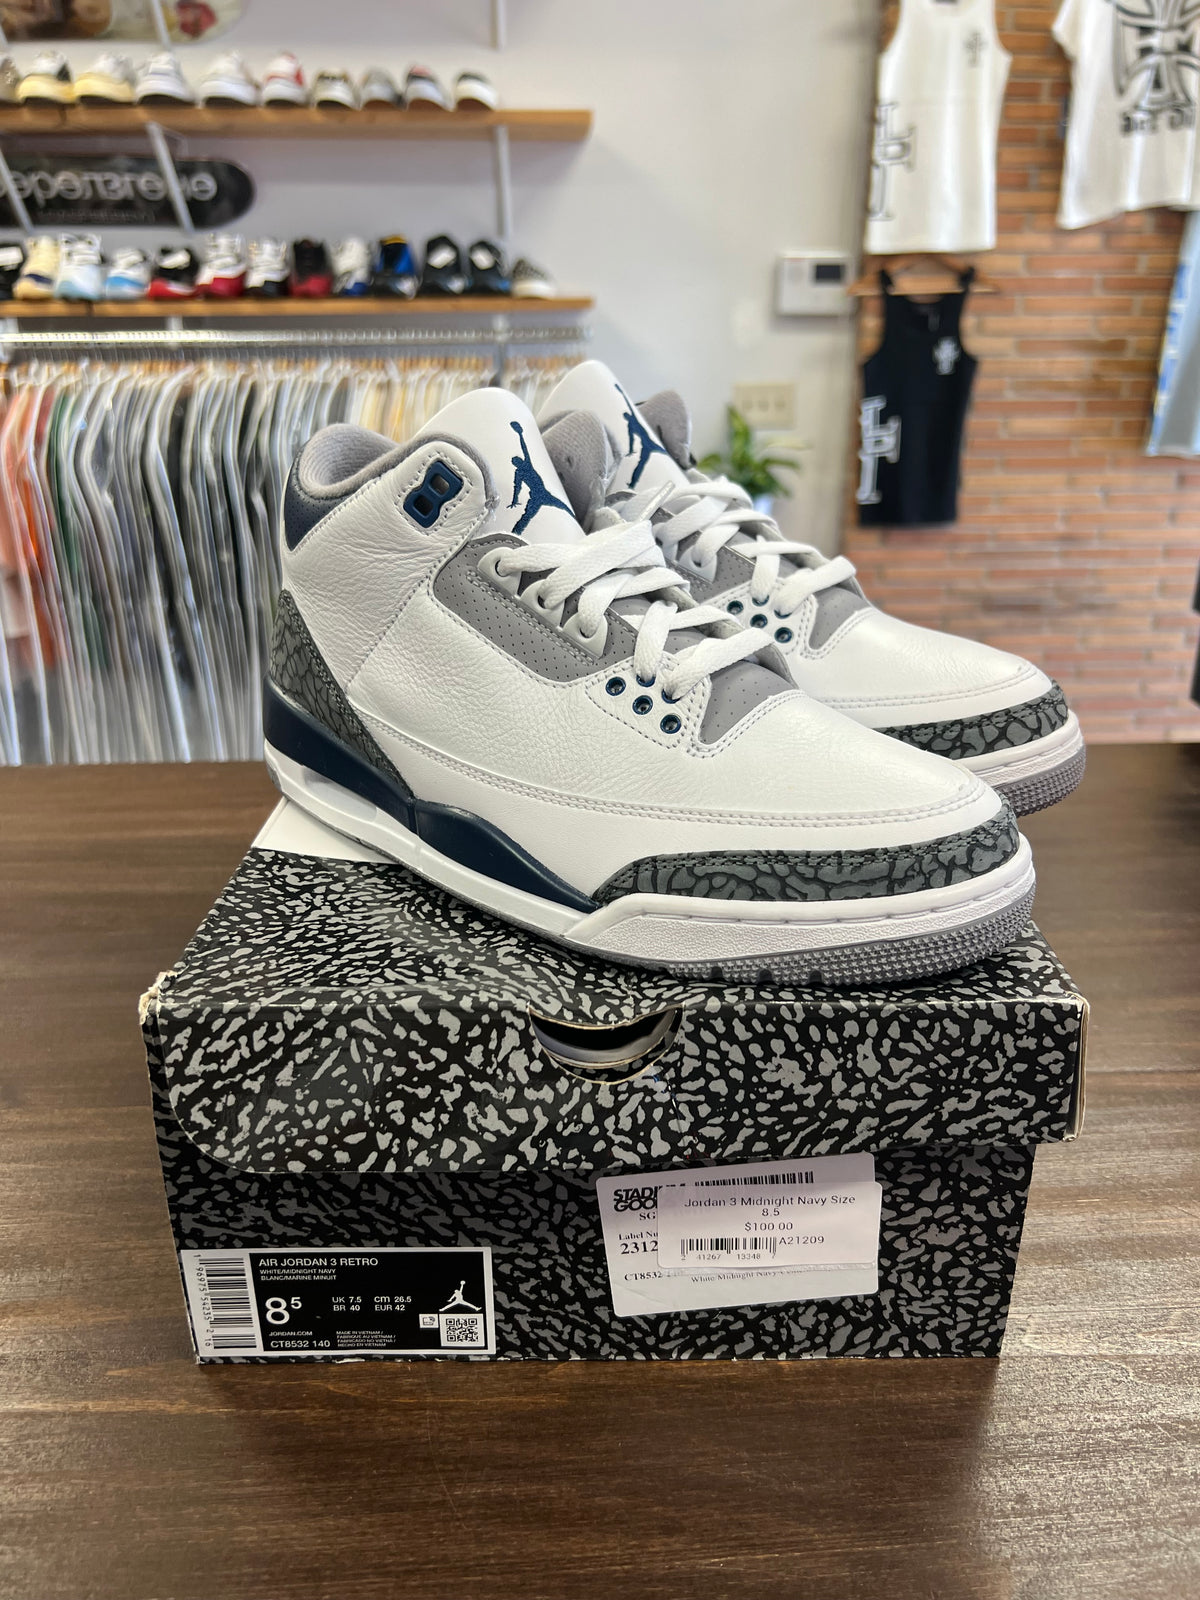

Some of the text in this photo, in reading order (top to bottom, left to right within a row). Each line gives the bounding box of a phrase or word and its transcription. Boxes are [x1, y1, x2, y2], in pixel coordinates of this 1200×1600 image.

[613, 1184, 675, 1202] STADI
[614, 1198, 658, 1212] GOO
[684, 1195, 856, 1207] Jordan 3 Midnight Navy Size
[761, 1208, 780, 1217] 8.5
[744, 1221, 793, 1232] $100.00
[619, 1231, 643, 1240] Label
[779, 1236, 825, 1245] A21209
[259, 1257, 379, 1267] AIR JORDAN 3 RETRO
[394, 1295, 412, 1303] 26.5
[270, 1340, 331, 1348] CT8532 140
